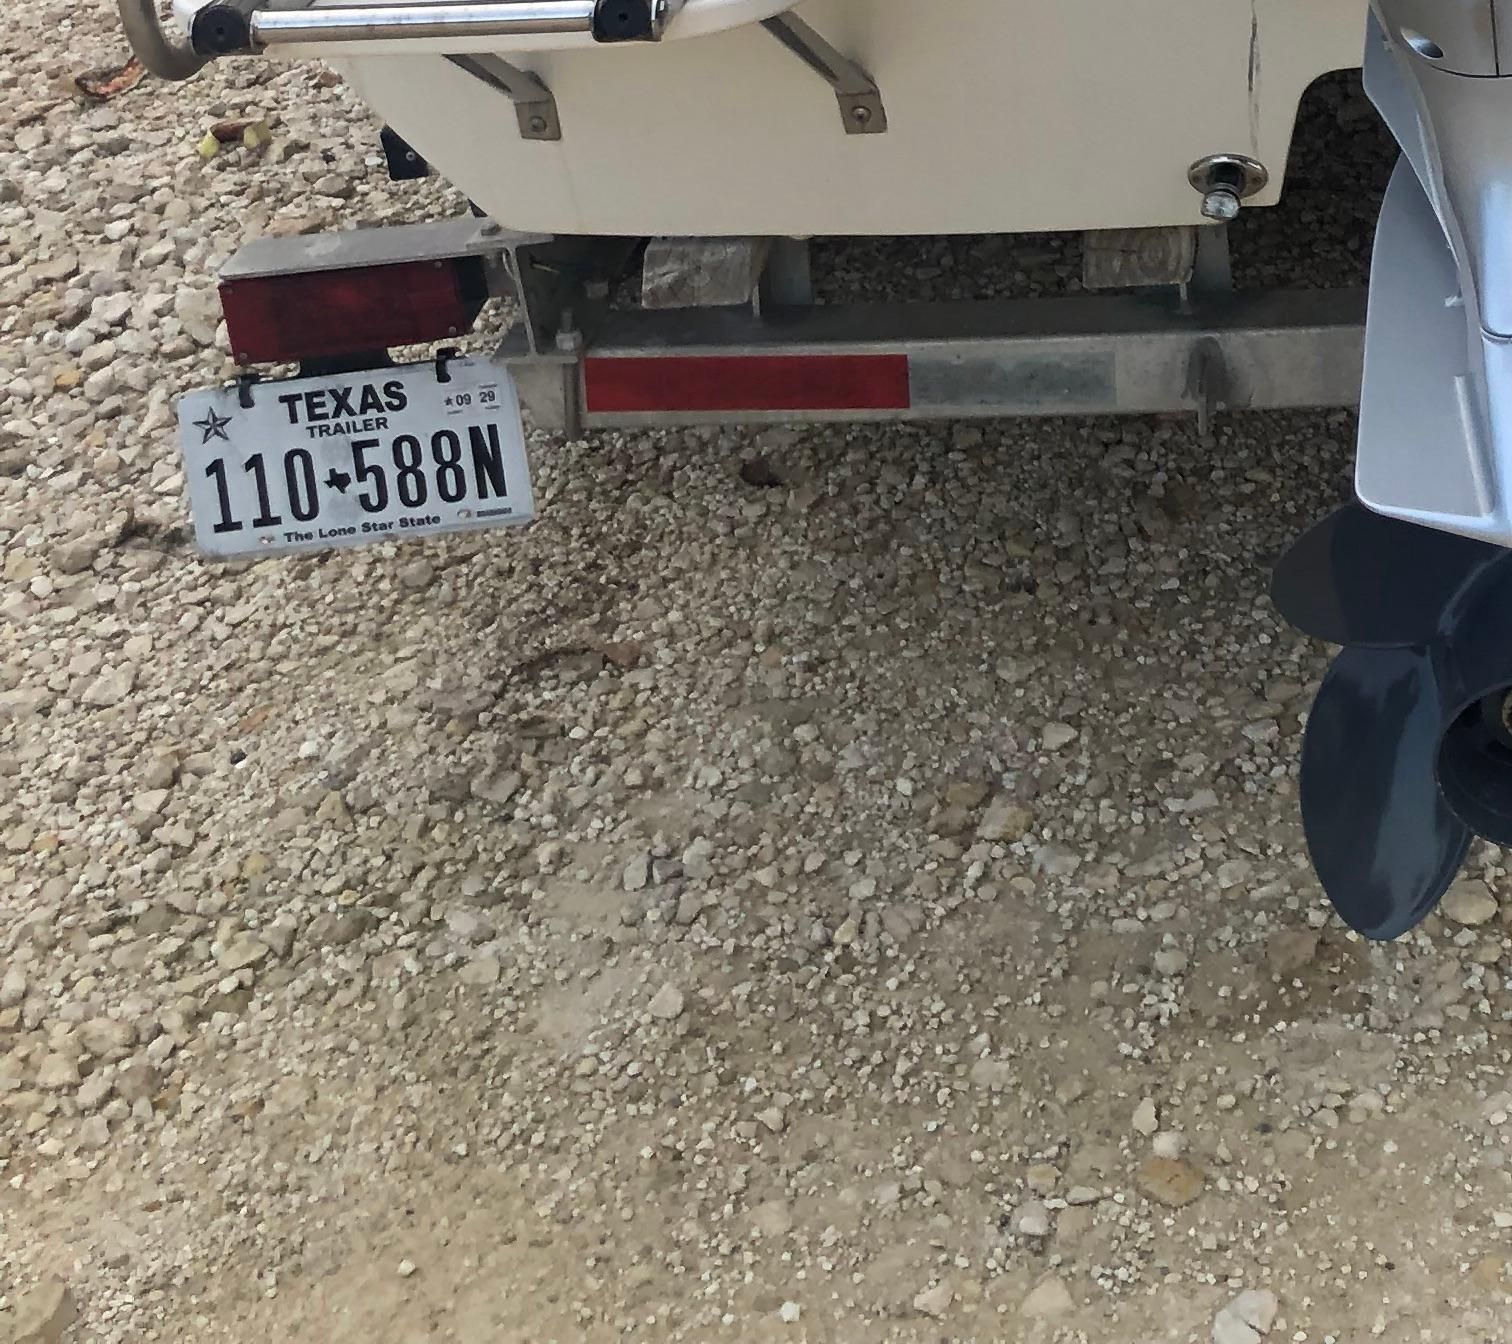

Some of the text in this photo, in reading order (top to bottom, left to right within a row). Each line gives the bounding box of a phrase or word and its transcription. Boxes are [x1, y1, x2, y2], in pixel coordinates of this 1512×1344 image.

[278, 380, 408, 425] TEXAS
[455, 390, 496, 406] 09 29
[305, 416, 389, 439] TRAILER
[283, 514, 441, 543] The Lone Star State
